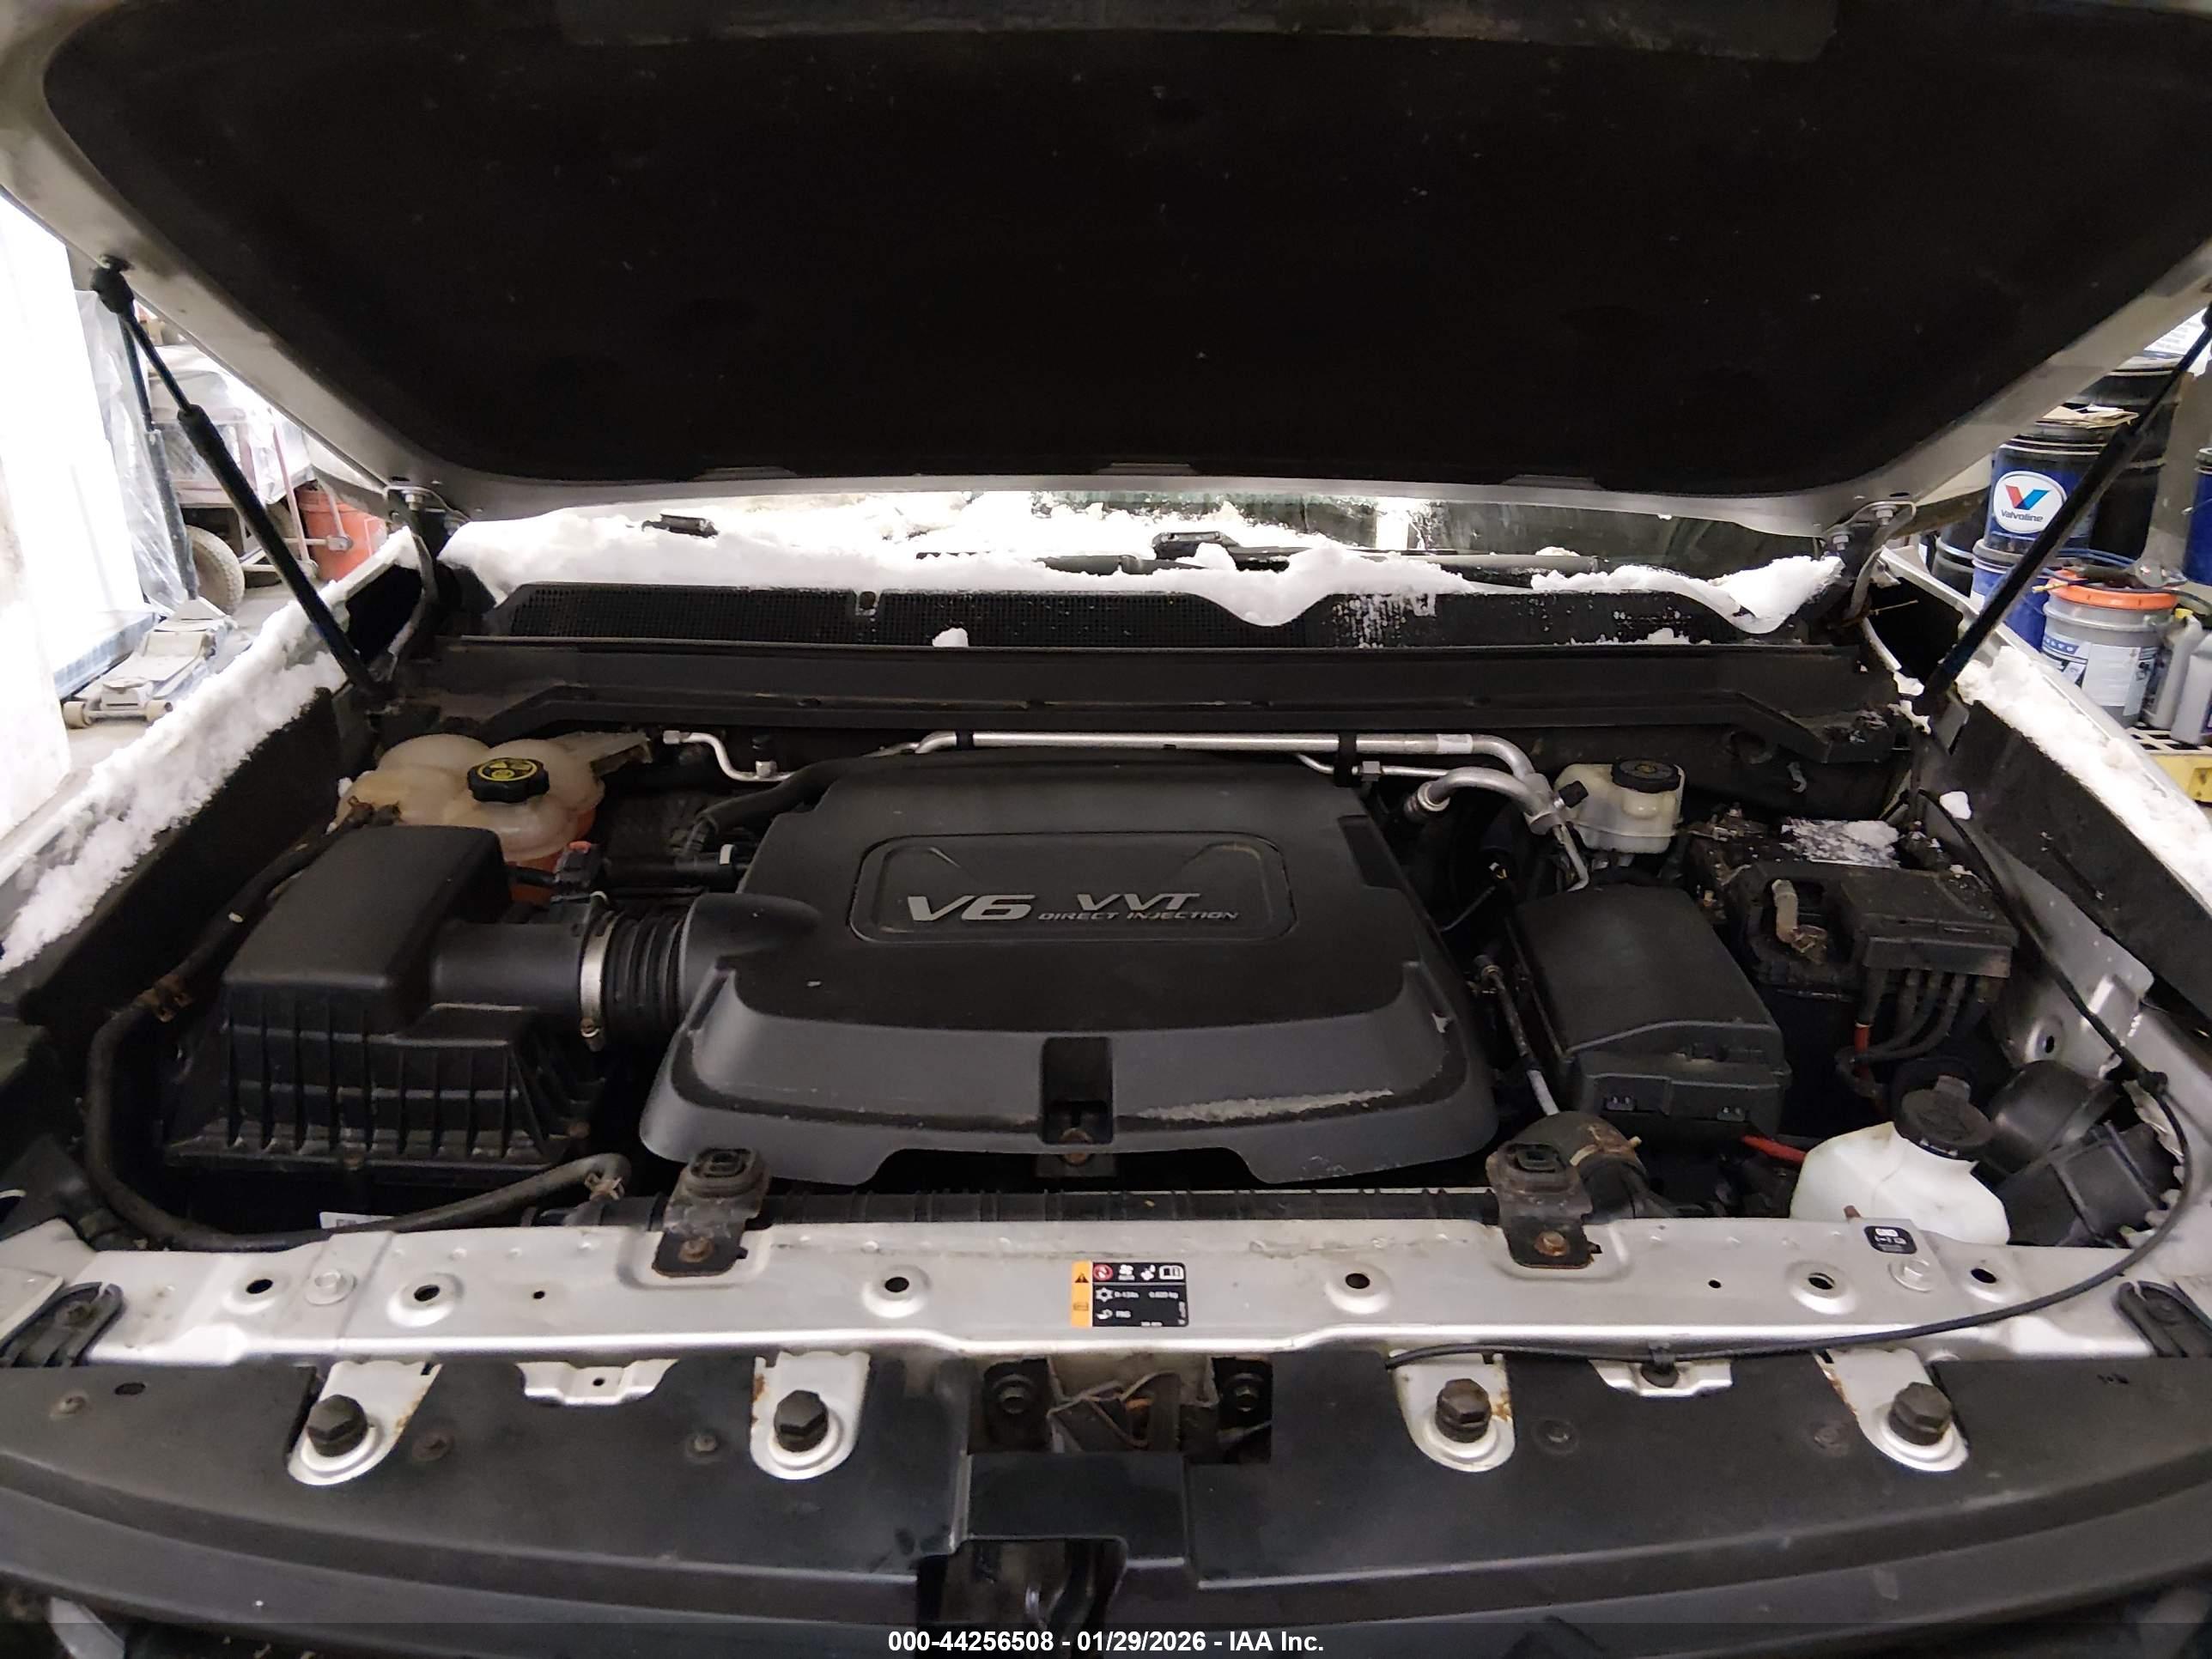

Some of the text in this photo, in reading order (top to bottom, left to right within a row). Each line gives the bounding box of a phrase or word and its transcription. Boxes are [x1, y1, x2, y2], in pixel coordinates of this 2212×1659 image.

[2002, 509, 2044, 522] Valvoline
[908, 893, 1200, 921] V6 VVT
[1037, 911, 1239, 921] DIRECT INJECTION
